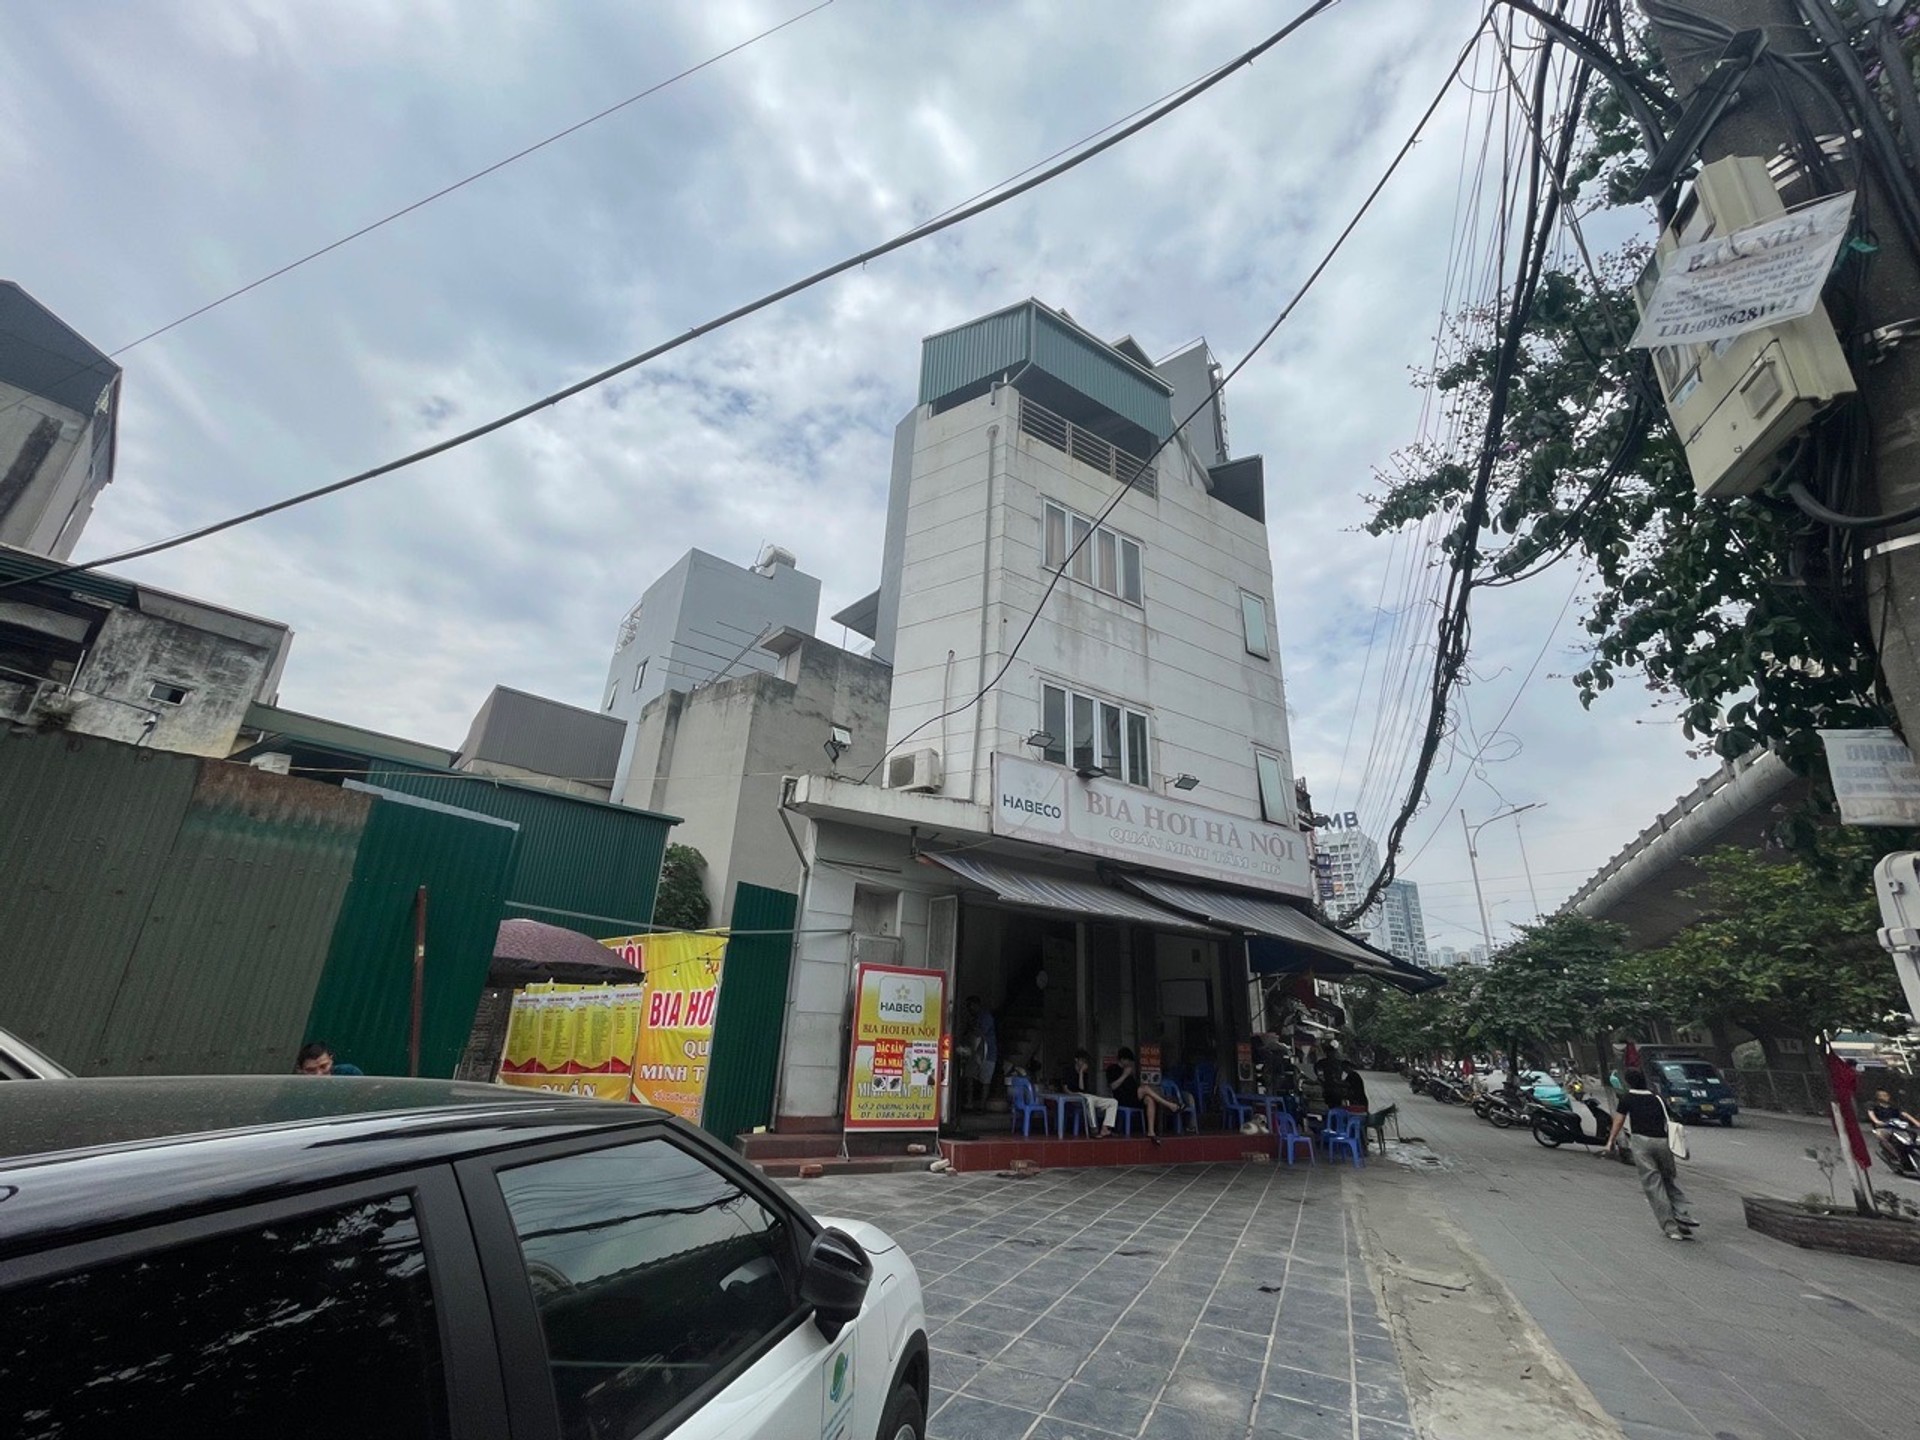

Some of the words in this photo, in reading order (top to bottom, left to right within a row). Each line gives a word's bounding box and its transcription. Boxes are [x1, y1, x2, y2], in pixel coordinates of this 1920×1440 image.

[1003, 794, 1061, 819] HABECO
[1085, 788, 1134, 825] BIA
[1142, 804, 1198, 839] HƠI
[1204, 820, 1243, 850] HÀ
[1250, 831, 1295, 862] NỘI
[1109, 826, 1162, 850] QUÁN
[1166, 840, 1210, 861] MINH
[1211, 849, 1250, 869] TÂM
[648, 991, 683, 1029] BIA
[683, 986, 717, 1029] HƠ
[880, 1002, 923, 1014] HABECO
[863, 1024, 878, 1034] BIA
[640, 1064, 687, 1081] MINH
